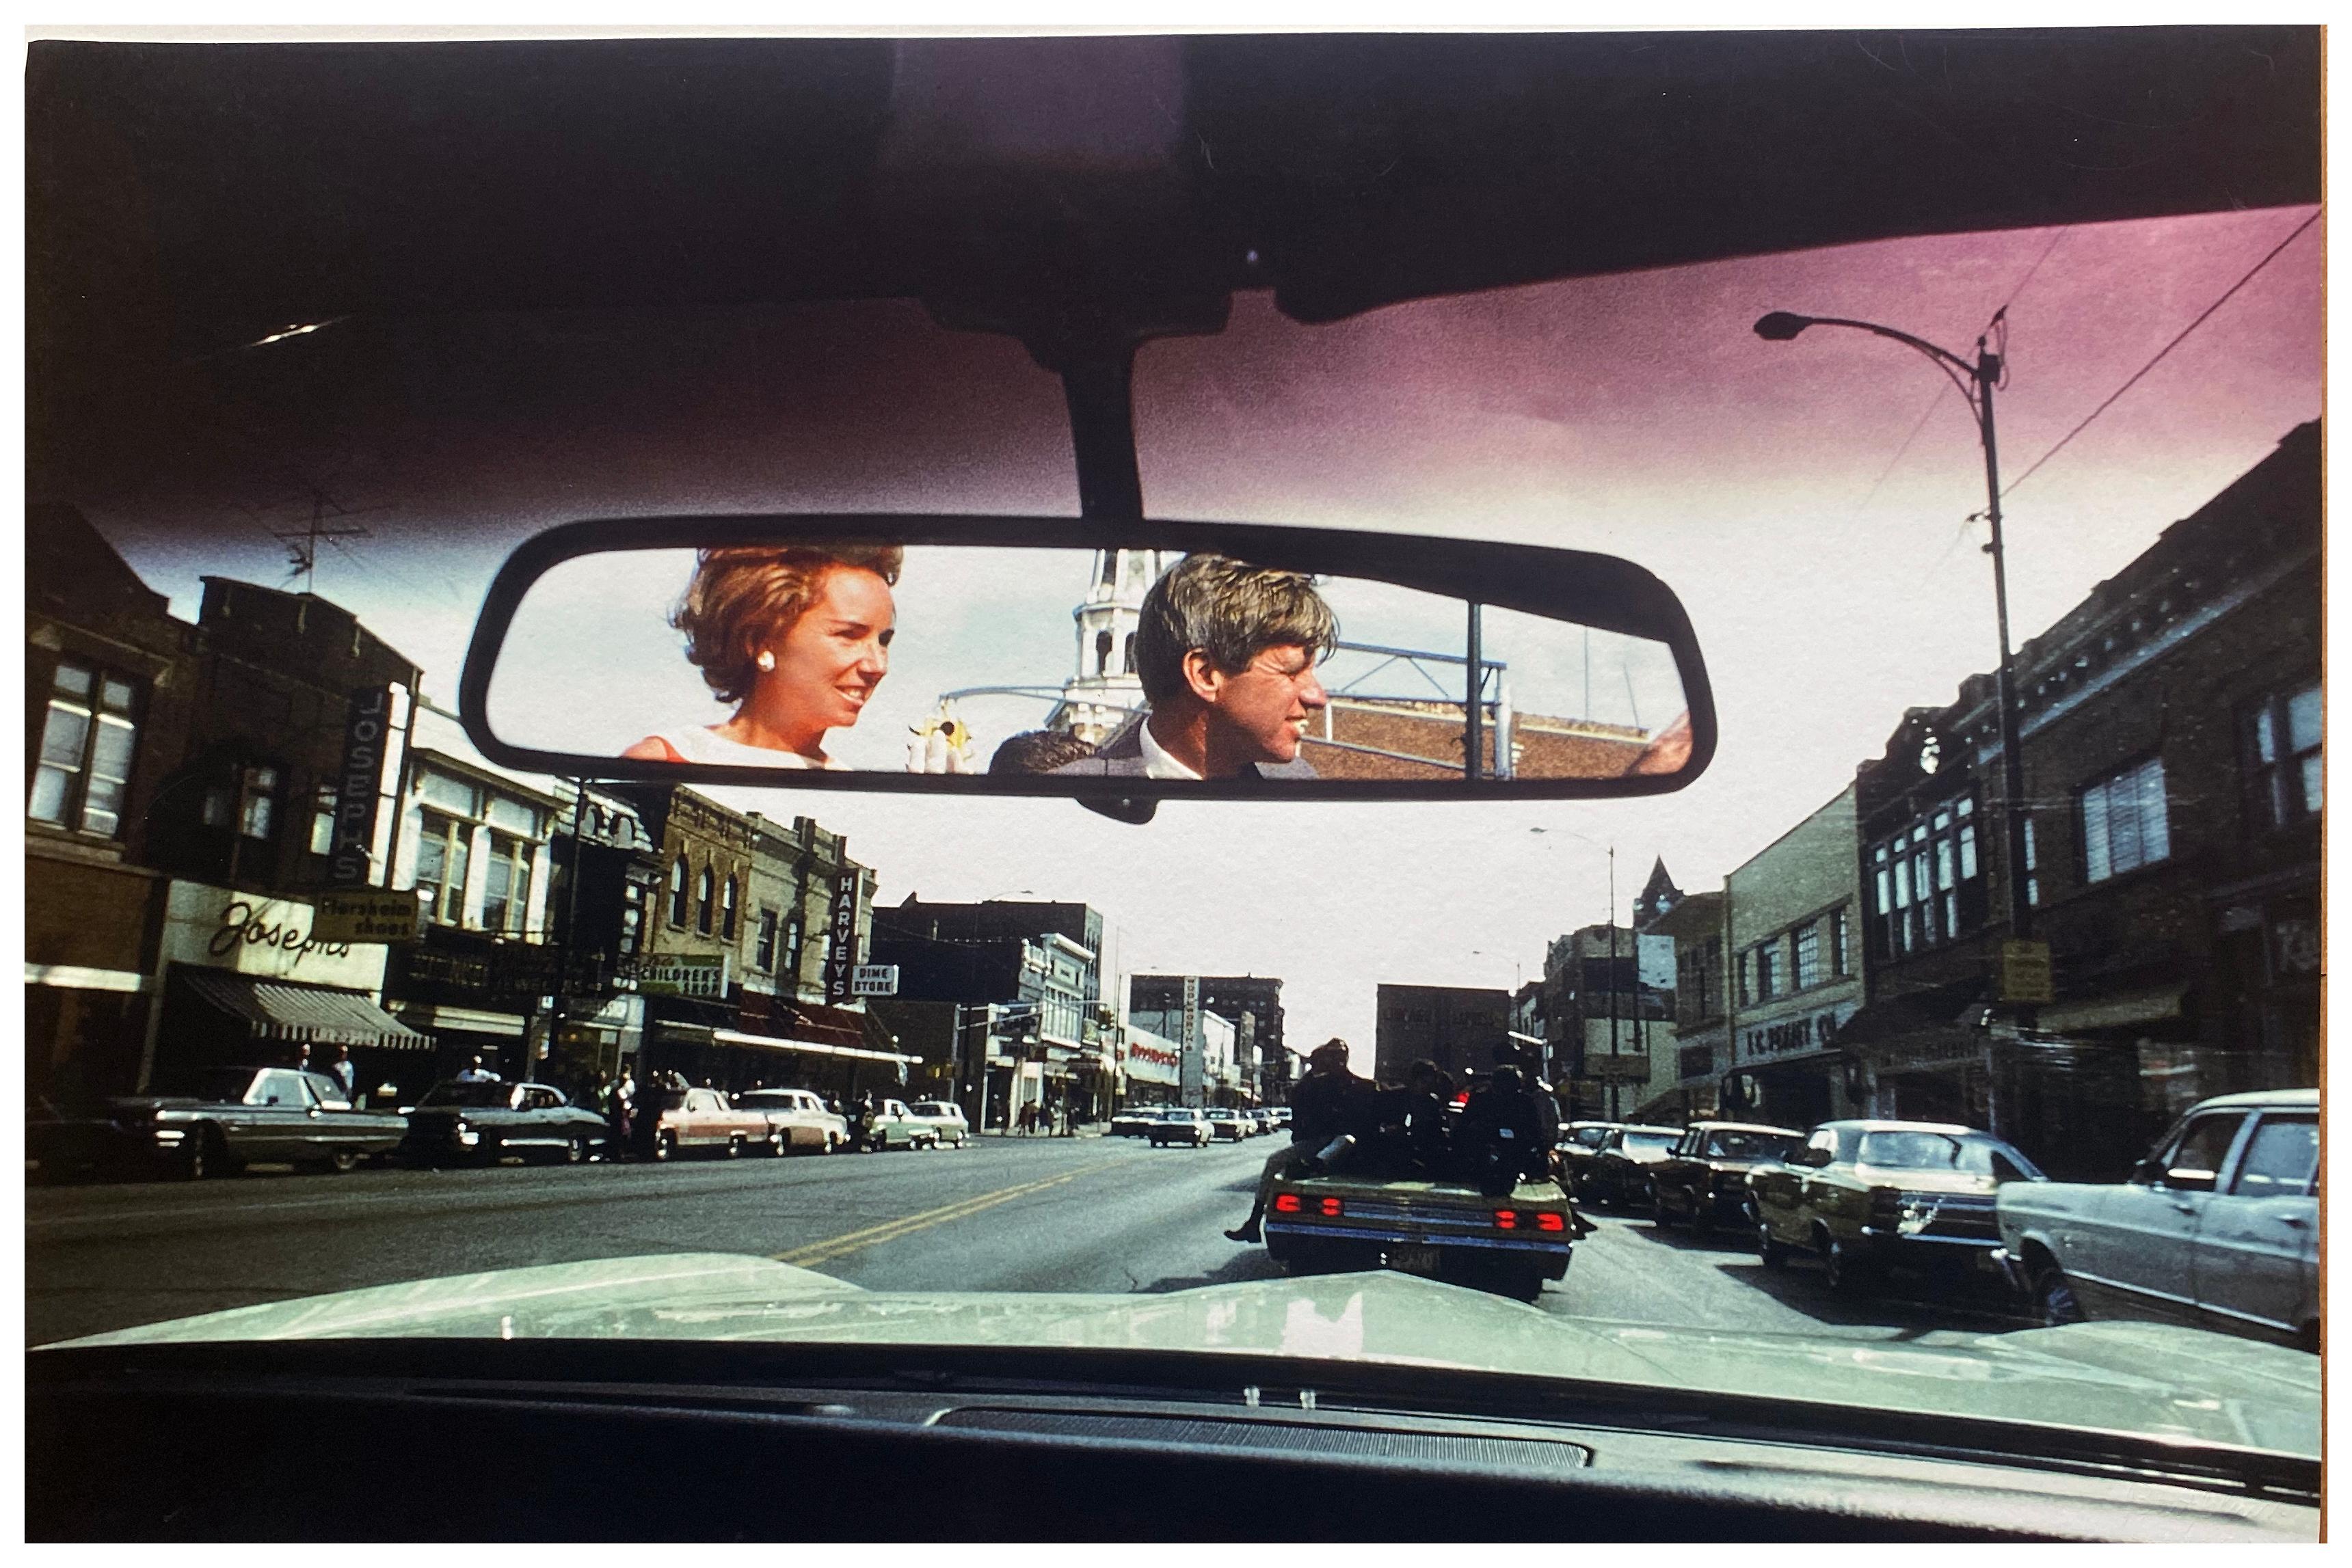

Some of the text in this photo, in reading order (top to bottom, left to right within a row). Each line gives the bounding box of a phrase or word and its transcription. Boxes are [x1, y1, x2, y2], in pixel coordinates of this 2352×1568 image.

[833, 877, 853, 995] HARVEYS
[859, 968, 888, 979] DIME
[854, 982, 892, 992] STORE
